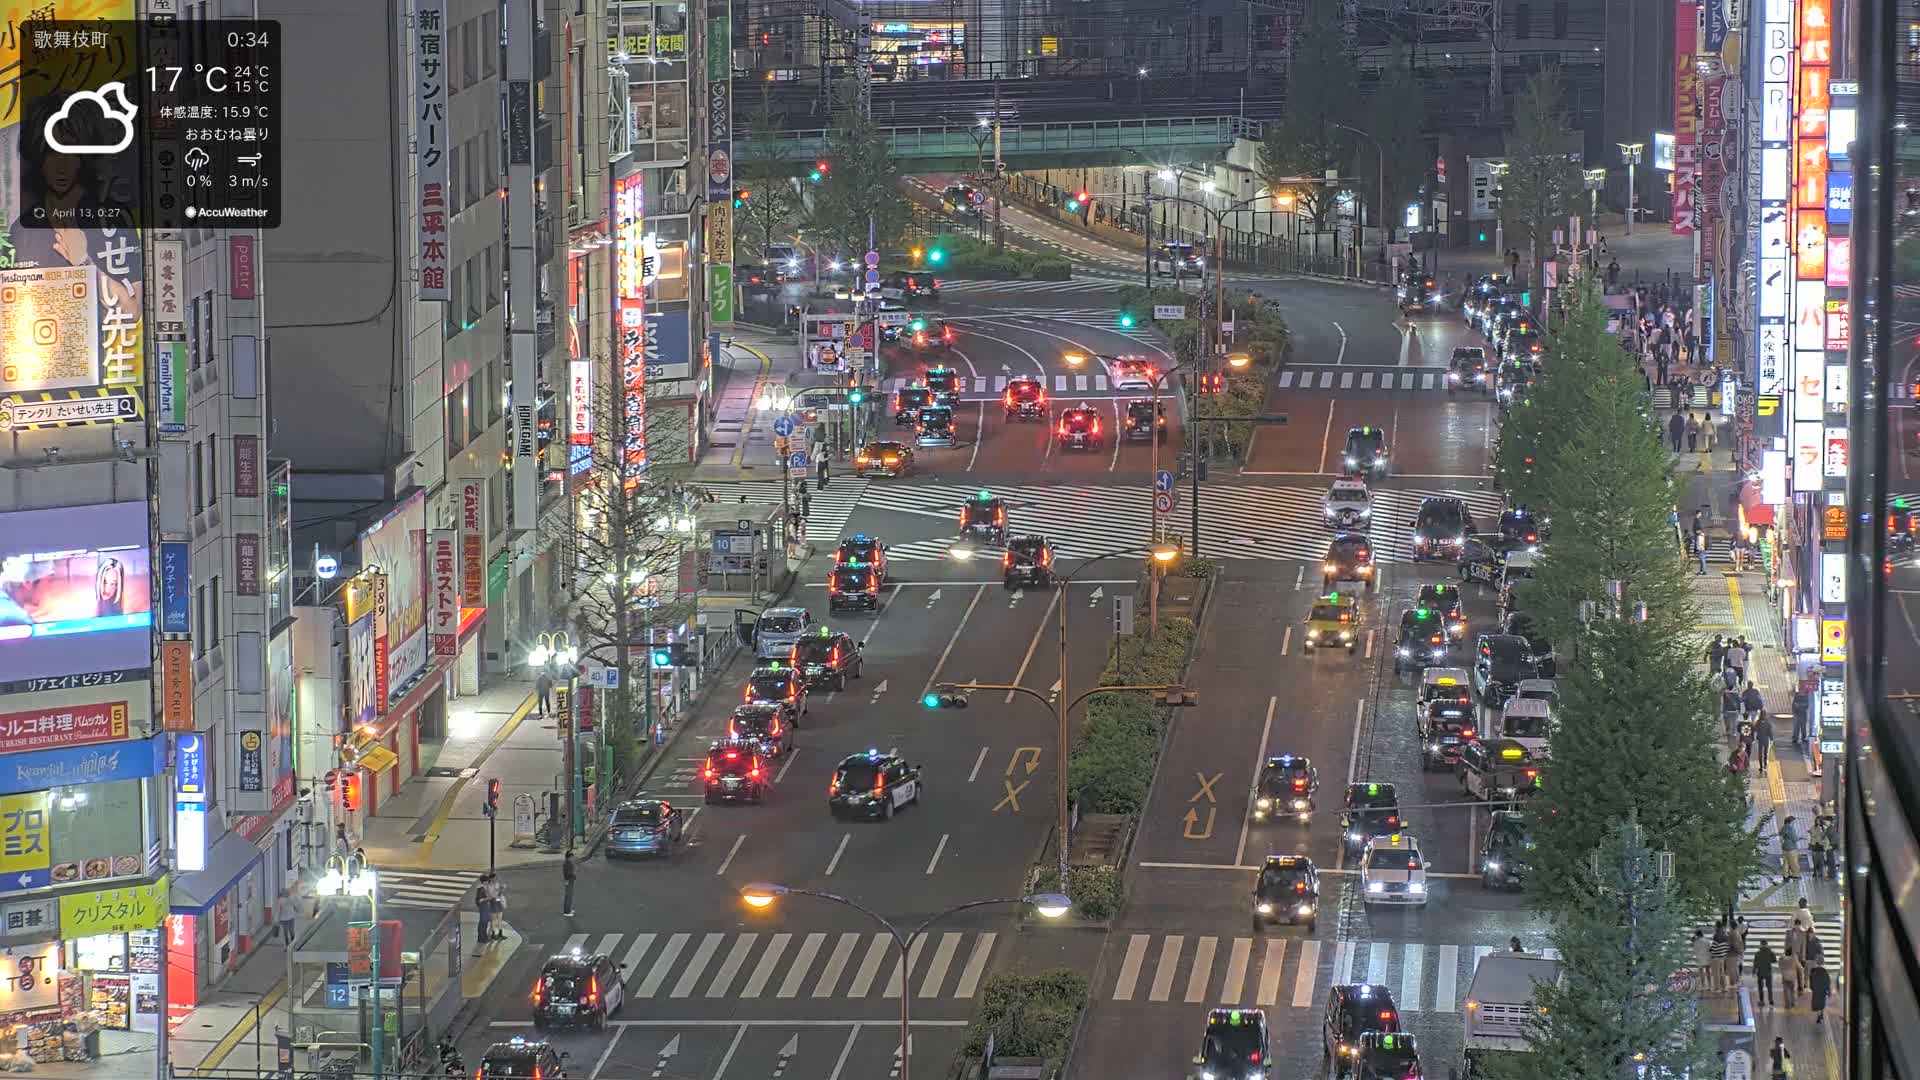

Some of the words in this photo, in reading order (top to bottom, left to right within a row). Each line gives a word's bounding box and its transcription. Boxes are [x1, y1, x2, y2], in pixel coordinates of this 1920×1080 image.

[419, 9, 443, 168] 新宿サンパーク
[1676, 145, 1696, 230] エスパス
[422, 182, 445, 290] 三平本館
[714, 207, 728, 260] 肉汁水餃子
[1, 272, 44, 286] Instagram
[714, 274, 727, 312] レイク
[162, 322, 179, 331] 3F
[159, 351, 172, 412] FamilyMart
[18, 409, 52, 419] テンクリ
[58, 403, 114, 416] たいせい先生
[519, 406, 531, 457] HOMEGAME
[464, 485, 475, 528] GAME
[717, 540, 729, 550] 10
[165, 552, 176, 604] ゲウチャイ
[436, 541, 453, 626] 三平ストア
[377, 579, 385, 616] 389
[28, 672, 123, 691] リアエイドビジョン
[29, 733, 73, 744] RESTAURANT
[113, 709, 123, 733] 5F
[8, 909, 43, 929] 囲碁
[73, 900, 146, 925] クリスタル
[331, 989, 346, 1001] 12
